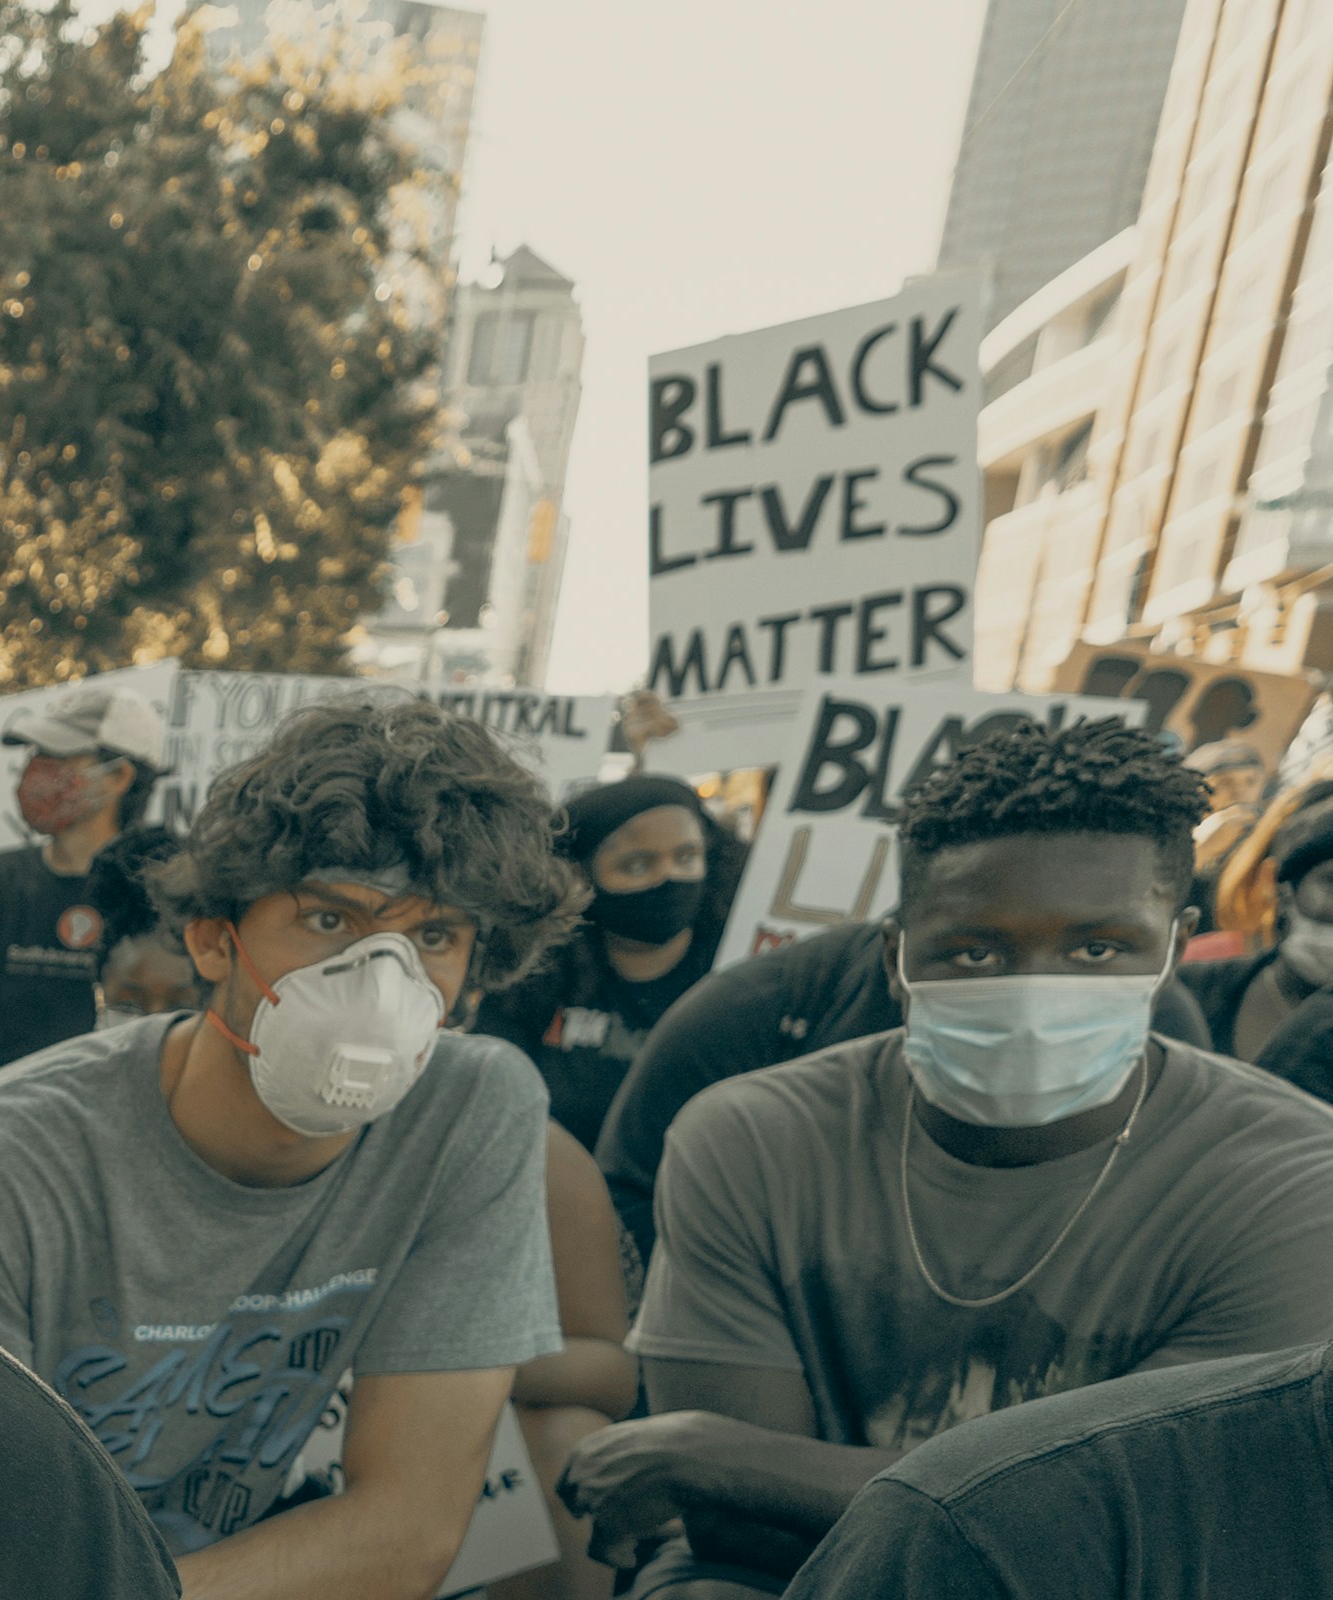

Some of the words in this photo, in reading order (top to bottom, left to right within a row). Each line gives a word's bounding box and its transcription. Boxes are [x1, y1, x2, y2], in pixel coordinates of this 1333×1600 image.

[649, 306, 965, 463] BLACK
[649, 455, 961, 577] LIVES
[649, 584, 967, 698] MATTER
[134, 1322, 219, 1342] CHARLO
